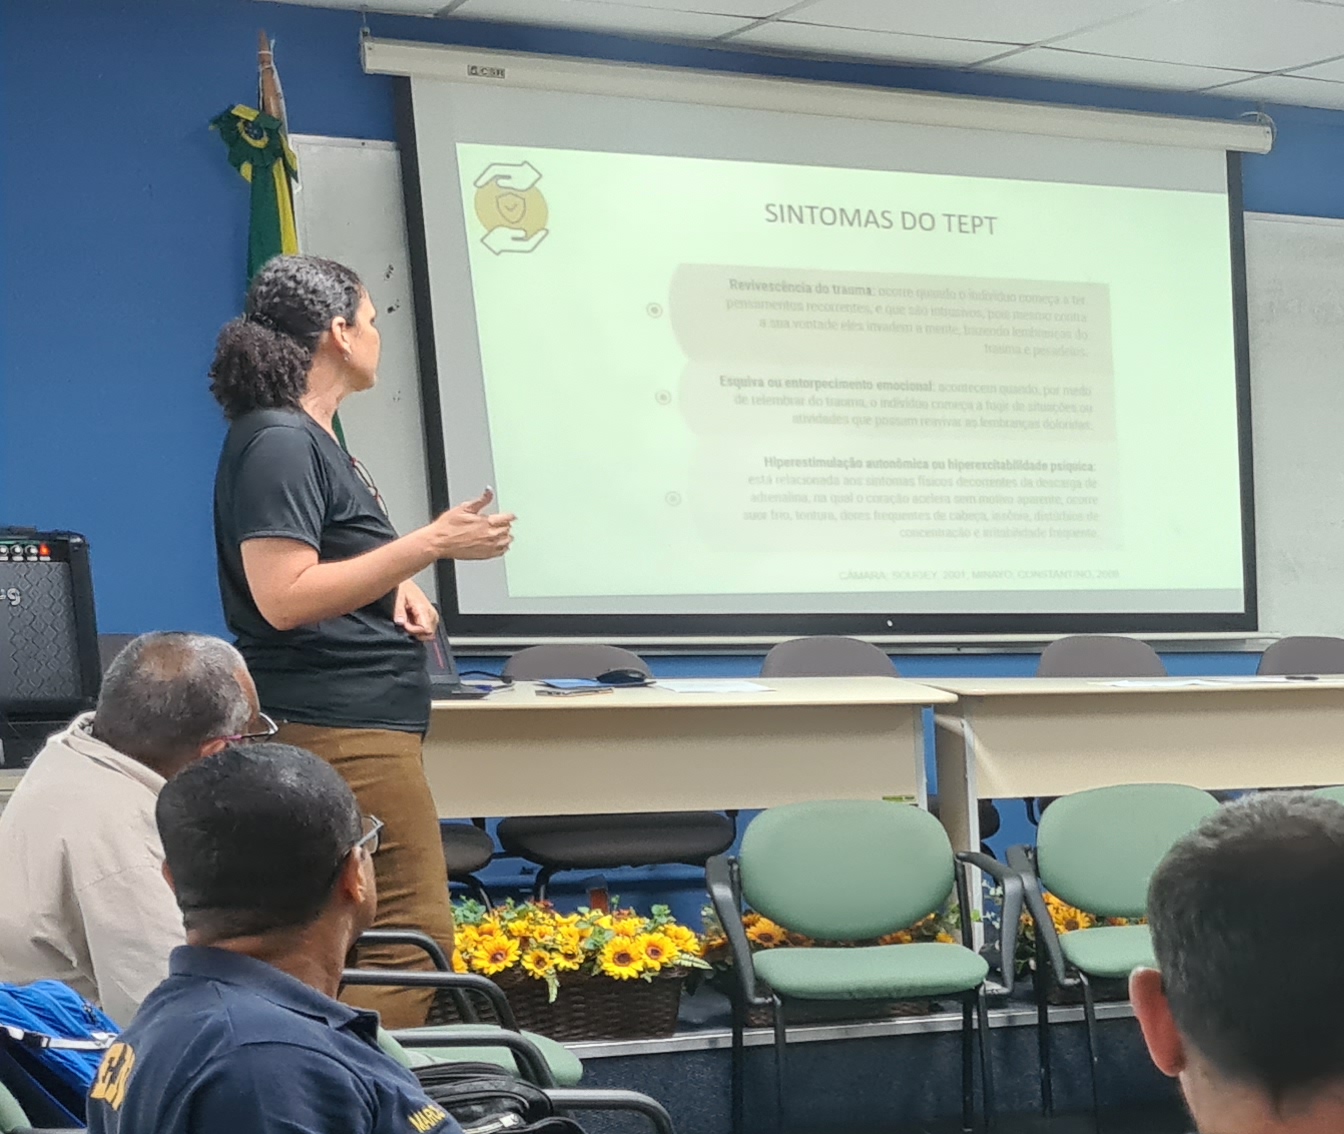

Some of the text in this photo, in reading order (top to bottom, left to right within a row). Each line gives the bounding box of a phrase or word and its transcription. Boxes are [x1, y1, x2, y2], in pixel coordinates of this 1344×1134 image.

[765, 203, 997, 235] SINTOMAS DO TEPT
[728, 279, 812, 293] Revivescência
[815, 282, 829, 294] do
[720, 376, 764, 390] Esquiva
[768, 380, 782, 388] ou
[785, 378, 873, 392] entorpecimento
[877, 380, 936, 392] emocional:
[735, 393, 749, 405] de
[808, 395, 823, 406] do
[764, 455, 863, 470] Hiperestimulação
[866, 457, 929, 469] autonômica
[932, 460, 946, 469] ou
[948, 458, 1048, 472] hiperexcitabilidade
